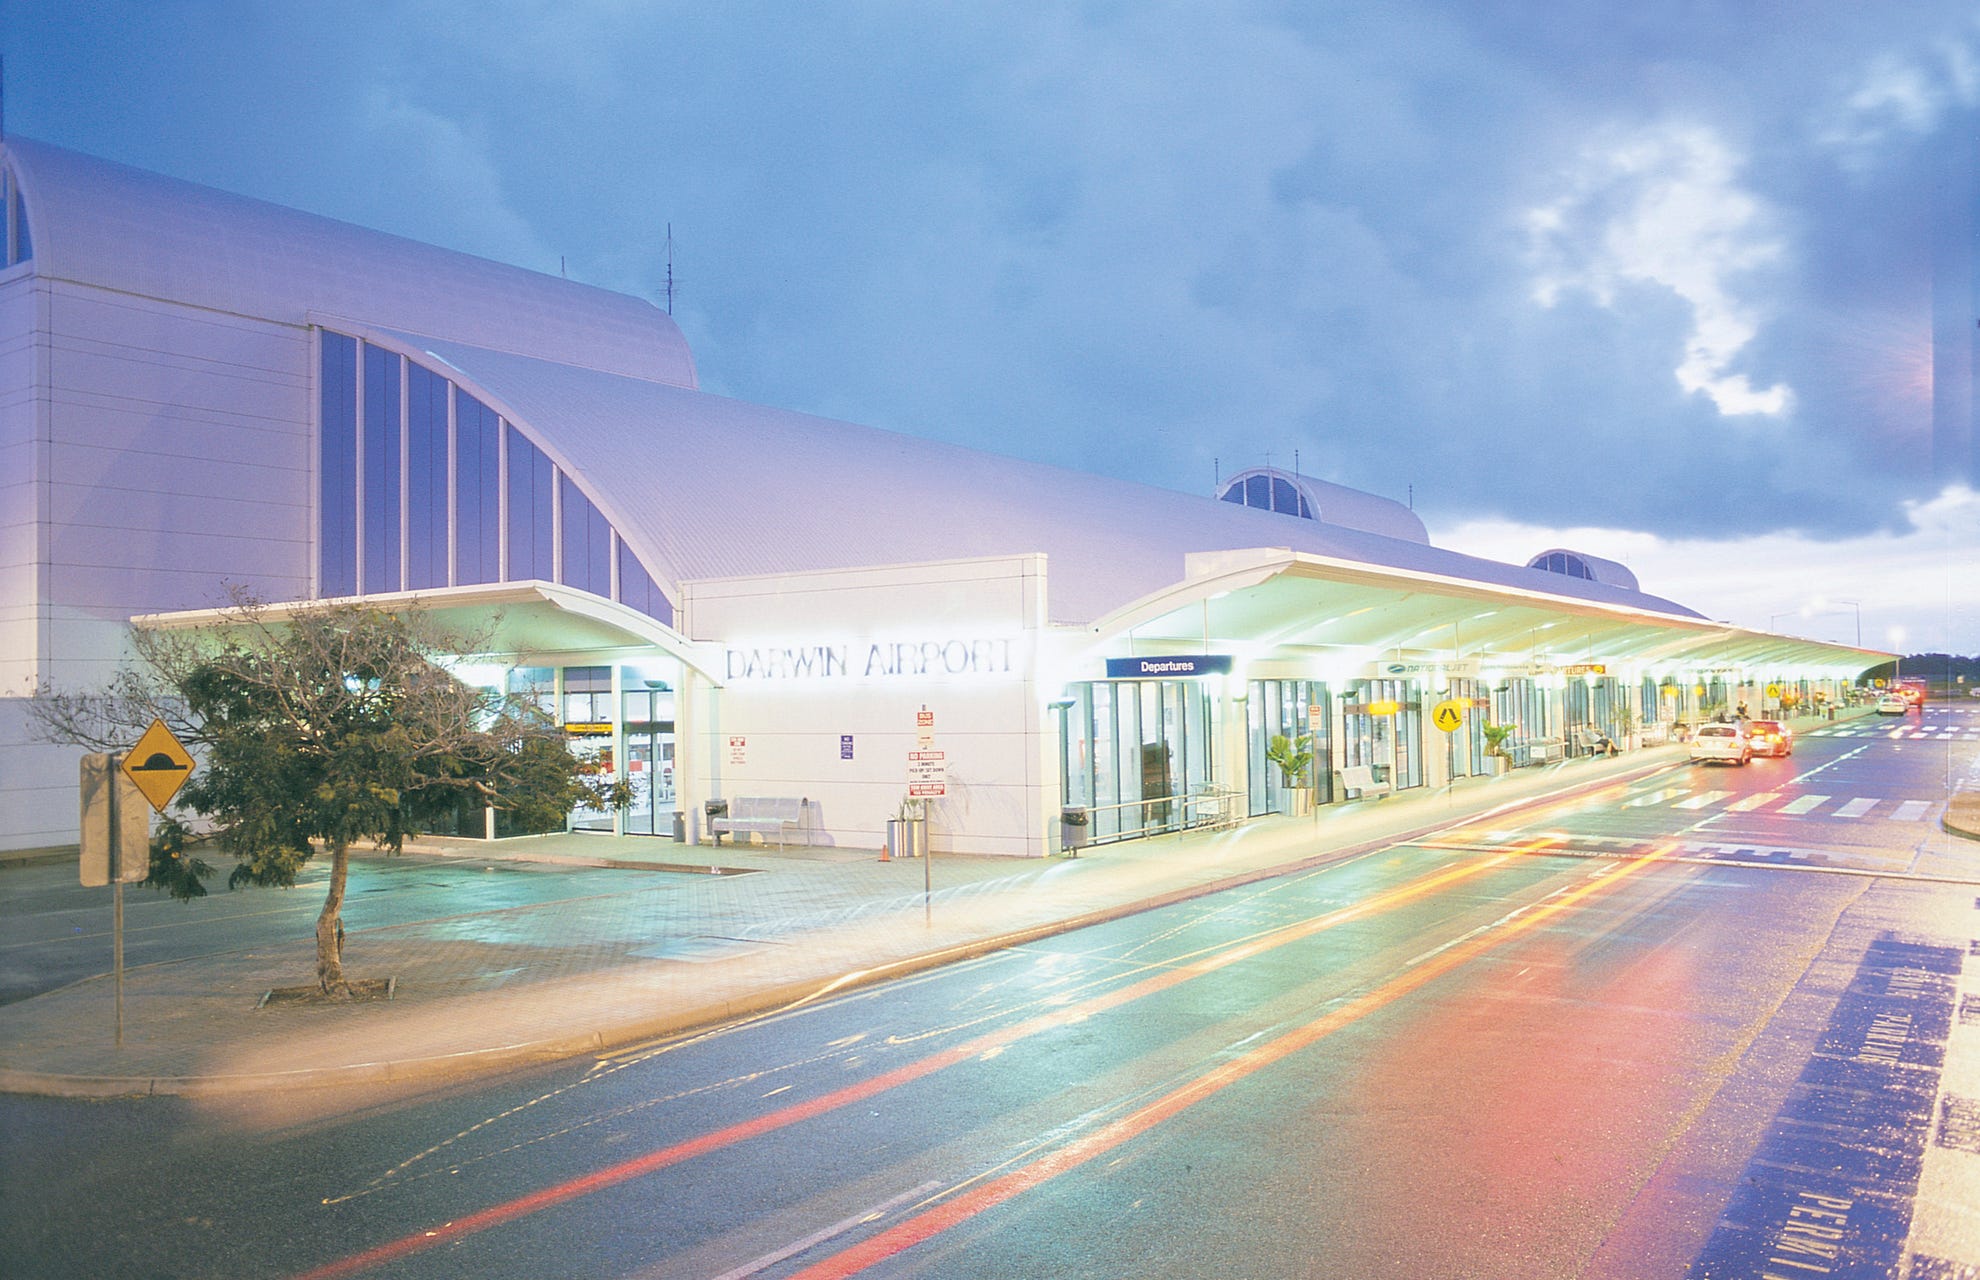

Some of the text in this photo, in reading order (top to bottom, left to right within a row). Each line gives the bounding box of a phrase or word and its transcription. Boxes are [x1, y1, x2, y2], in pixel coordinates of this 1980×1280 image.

[726, 638, 1015, 680] DARWIN AIRPORT
[1140, 660, 1195, 674] Departures
[1762, 1192, 1854, 1280] PERMI
